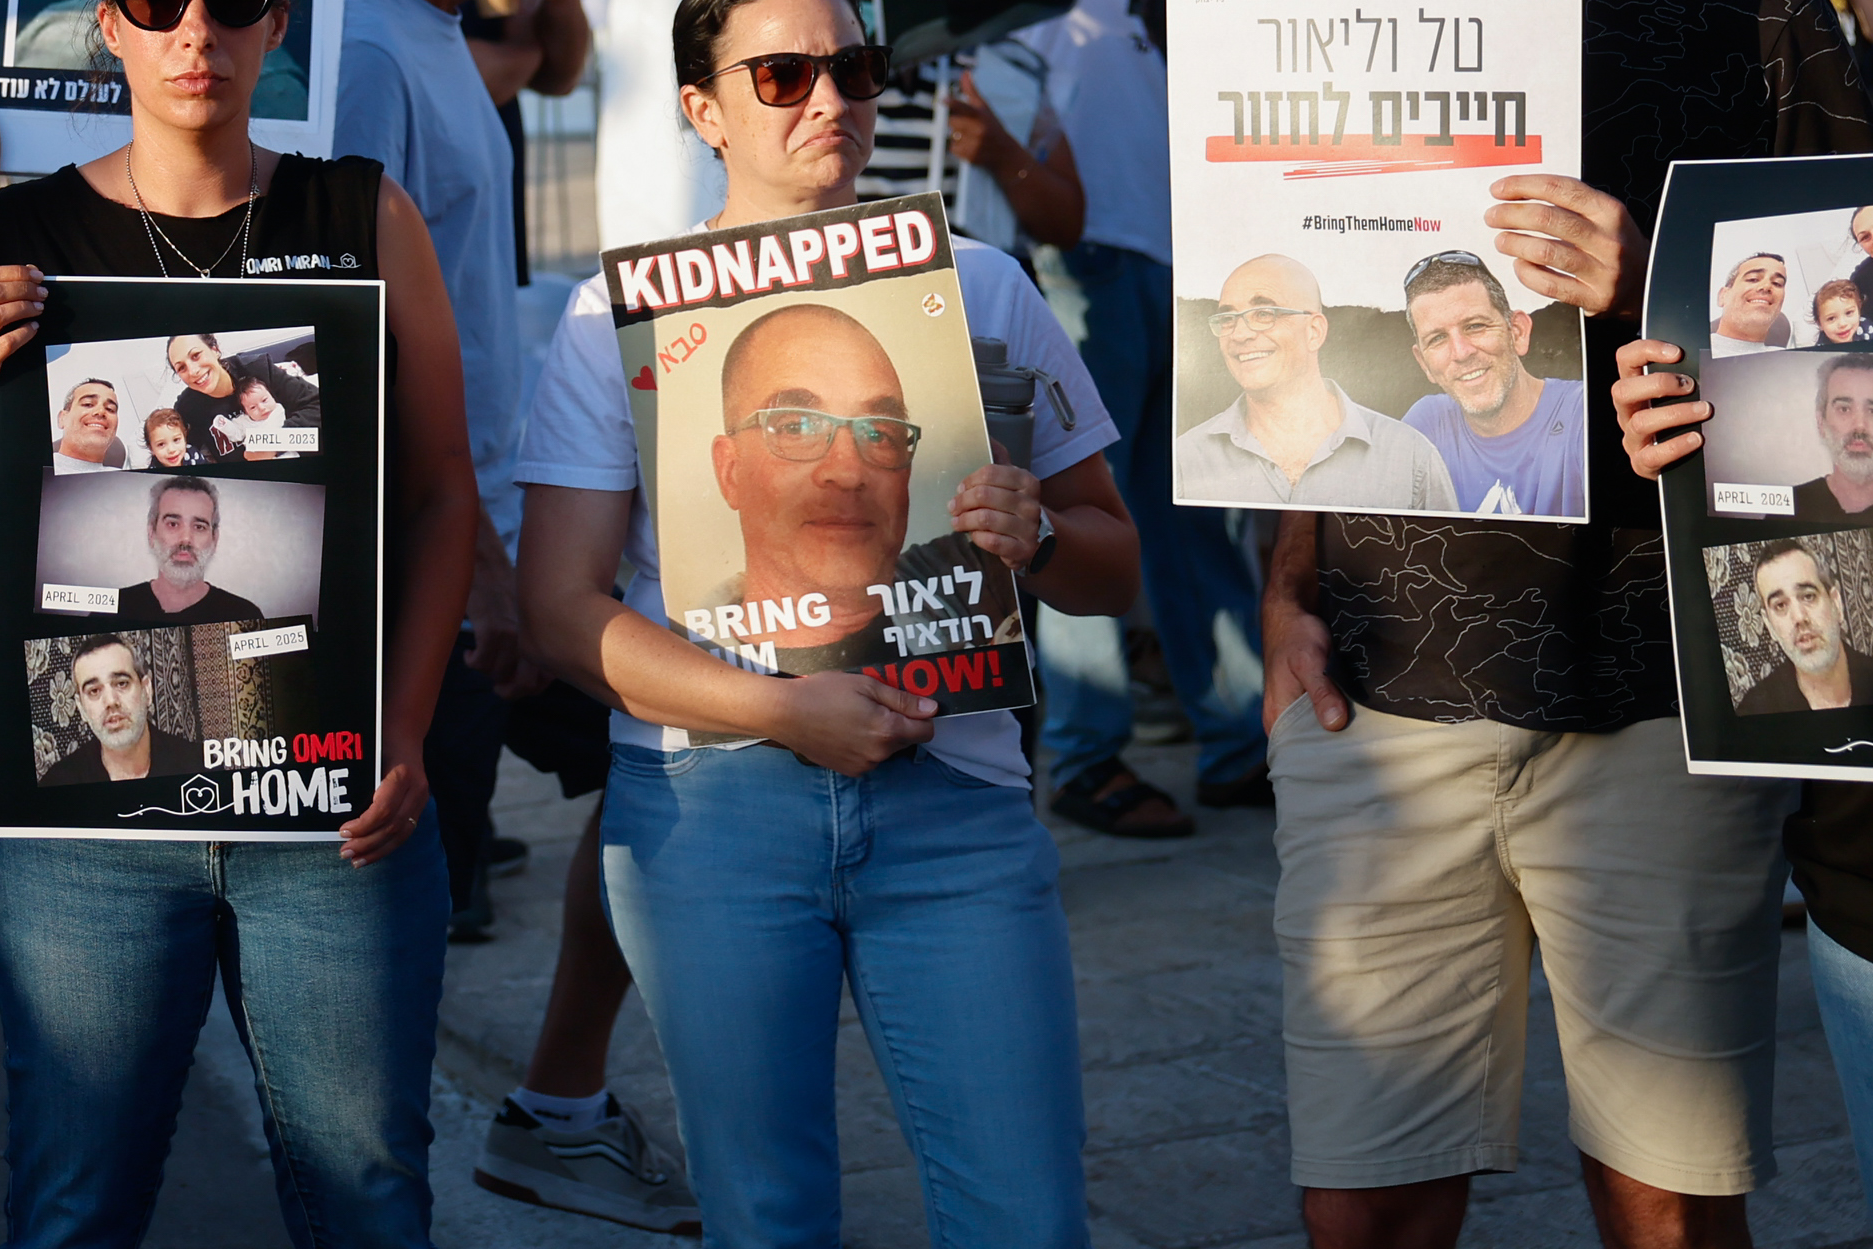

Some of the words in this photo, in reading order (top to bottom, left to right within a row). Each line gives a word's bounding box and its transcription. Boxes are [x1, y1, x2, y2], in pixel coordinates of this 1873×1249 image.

[1257, 8, 1398, 73] וליאור
[1418, 7, 1483, 73] טל
[34, 77, 61, 100] לא
[1217, 81, 1351, 146] לחזור
[1368, 90, 1527, 147] חייבים
[1302, 215, 1442, 234] #BringThemHomeNow
[246, 257, 283, 274] OMRI
[284, 253, 331, 270] MIRAN
[617, 209, 938, 314] KIDNAPPED
[248, 434, 282, 445] APRIL
[288, 434, 316, 445] 2023
[1717, 490, 1754, 505] APRIL
[1760, 492, 1791, 507] 2024
[45, 590, 80, 604] APRIL
[87, 593, 116, 606] 2024
[866, 565, 983, 617] ליאור
[684, 592, 832, 643] BRING
[883, 613, 995, 658] רודאיף
[234, 637, 269, 652] APRIL
[275, 631, 305, 646] 2025
[203, 736, 288, 769] BRING
[292, 731, 364, 764] OMRI
[232, 766, 353, 817] HOME
